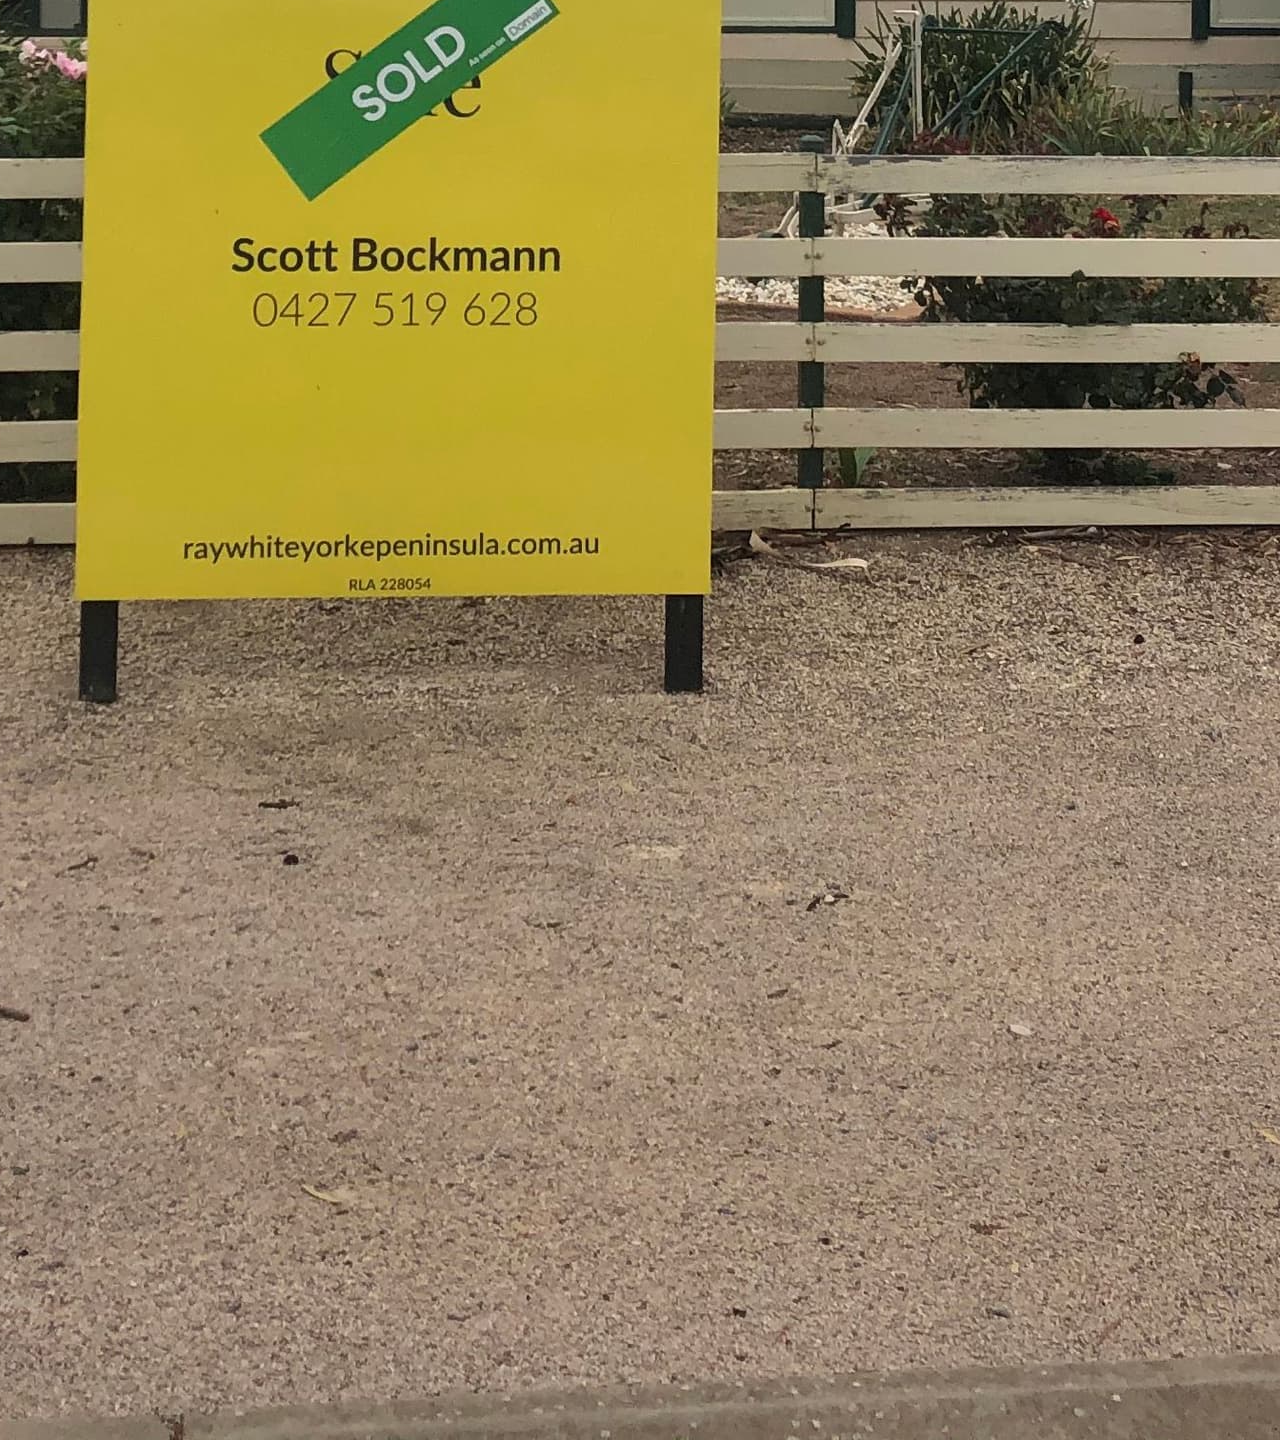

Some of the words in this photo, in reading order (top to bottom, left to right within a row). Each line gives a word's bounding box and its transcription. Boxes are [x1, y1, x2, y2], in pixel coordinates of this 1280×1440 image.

[508, 4, 549, 37] Domain
[351, 24, 467, 122] SOLD
[231, 237, 339, 273] Scott
[351, 236, 562, 272] Bockmann
[251, 291, 357, 328] 0427
[372, 291, 448, 327] 519
[463, 291, 539, 327] 628
[183, 531, 600, 565] raywhiteyorkepeninsula.com.au
[348, 578, 376, 592] RLA
[380, 577, 432, 591] 228054
